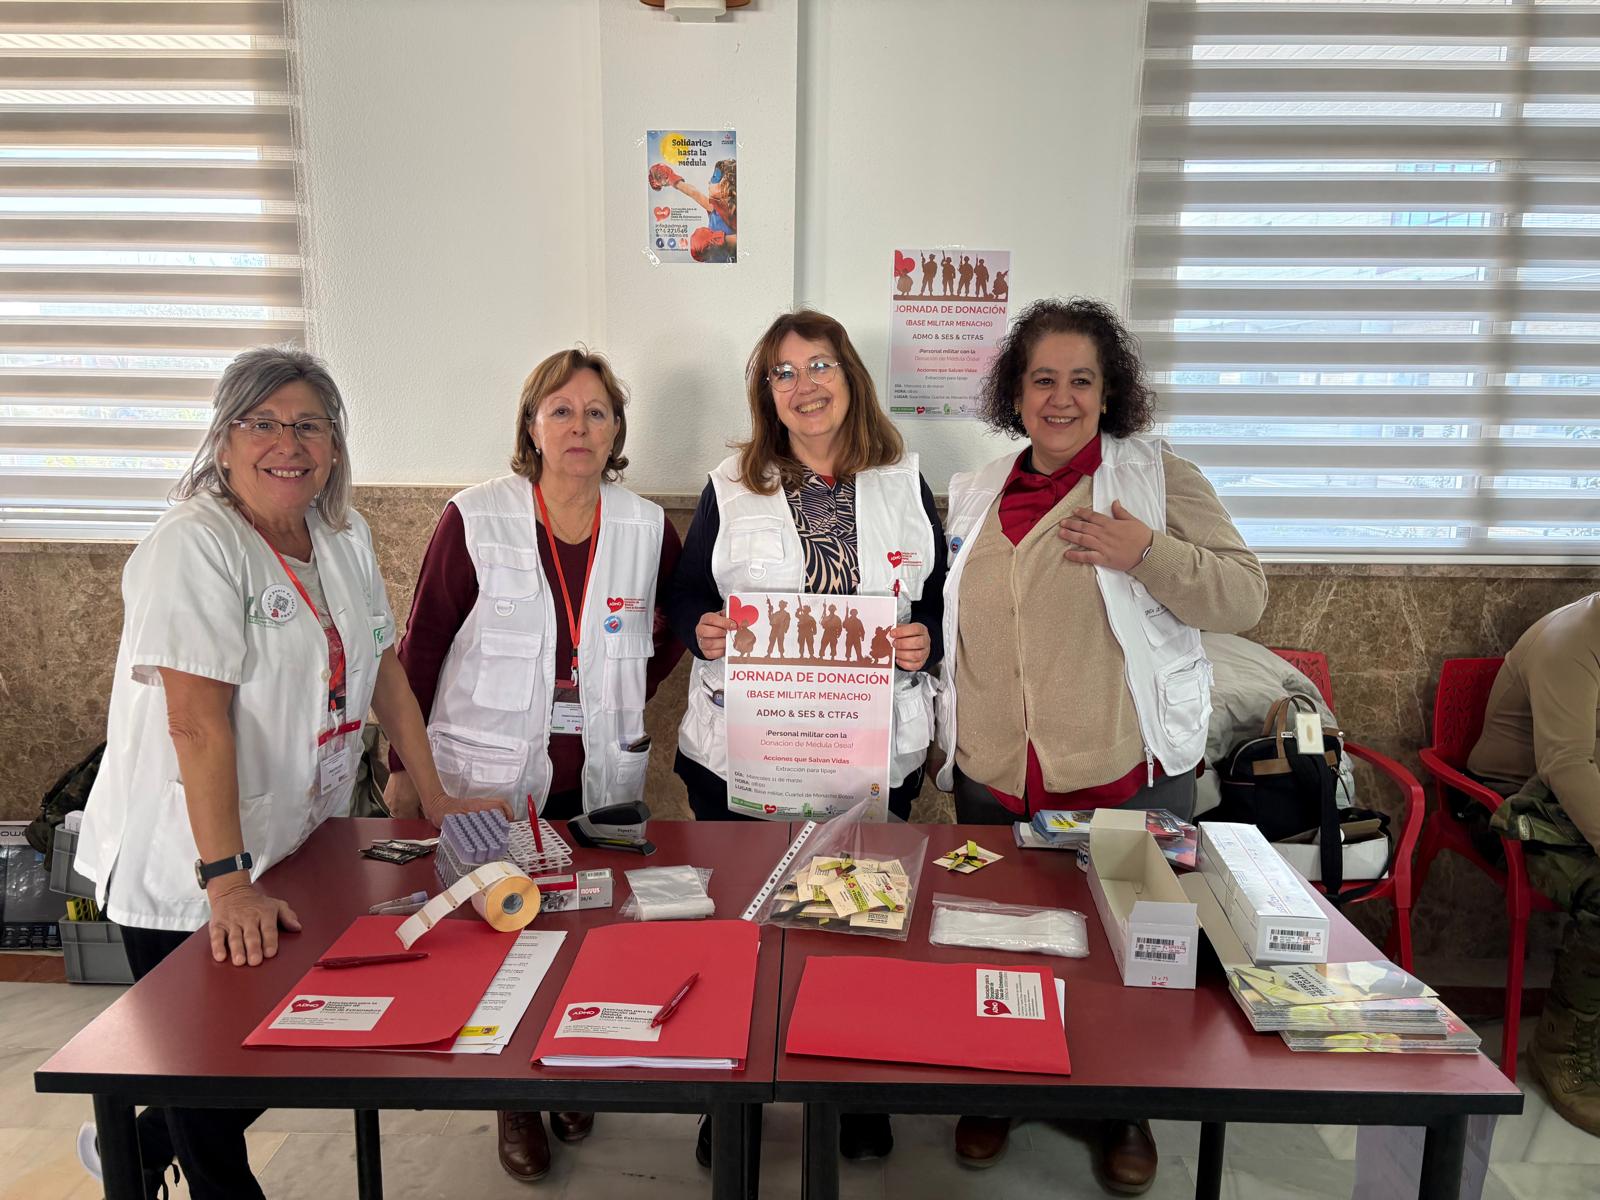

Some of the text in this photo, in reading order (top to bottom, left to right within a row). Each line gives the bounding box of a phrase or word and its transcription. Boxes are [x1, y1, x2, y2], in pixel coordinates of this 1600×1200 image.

[672, 139, 712, 147] Solidari@s
[678, 158, 706, 166] médula
[896, 305, 938, 313] JORNADA
[956, 304, 1006, 314] DONACIÓN
[730, 670, 889, 685] JORNADA DE DONACIÓN
[746, 690, 871, 702] (BASE MILITAR MENACHO)
[756, 709, 786, 718] ADMO
[828, 711, 859, 719] CTFAS
